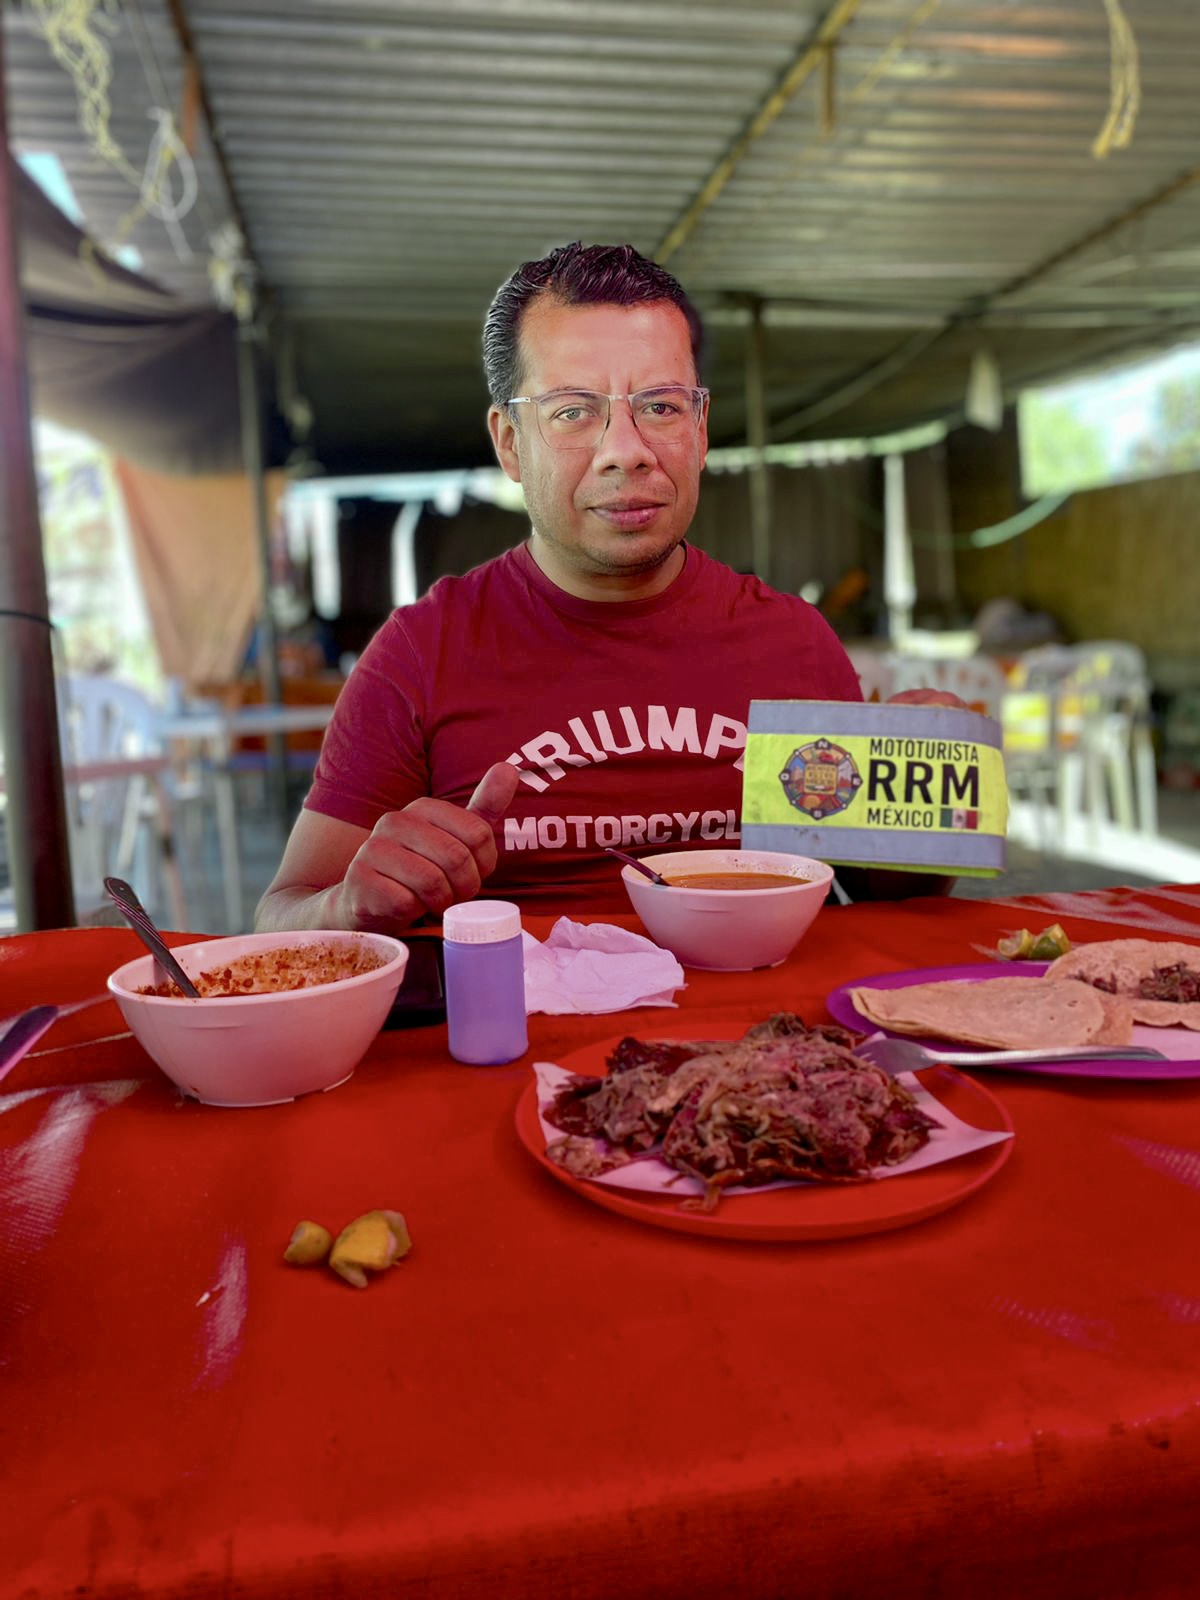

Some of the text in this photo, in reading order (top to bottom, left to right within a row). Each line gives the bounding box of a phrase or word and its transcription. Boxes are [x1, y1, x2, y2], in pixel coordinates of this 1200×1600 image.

[505, 705, 747, 793] TRIUMP
[870, 738, 979, 763] MOTOTURISTA
[867, 759, 979, 808] RRM
[867, 805, 934, 828] MÉXICO
